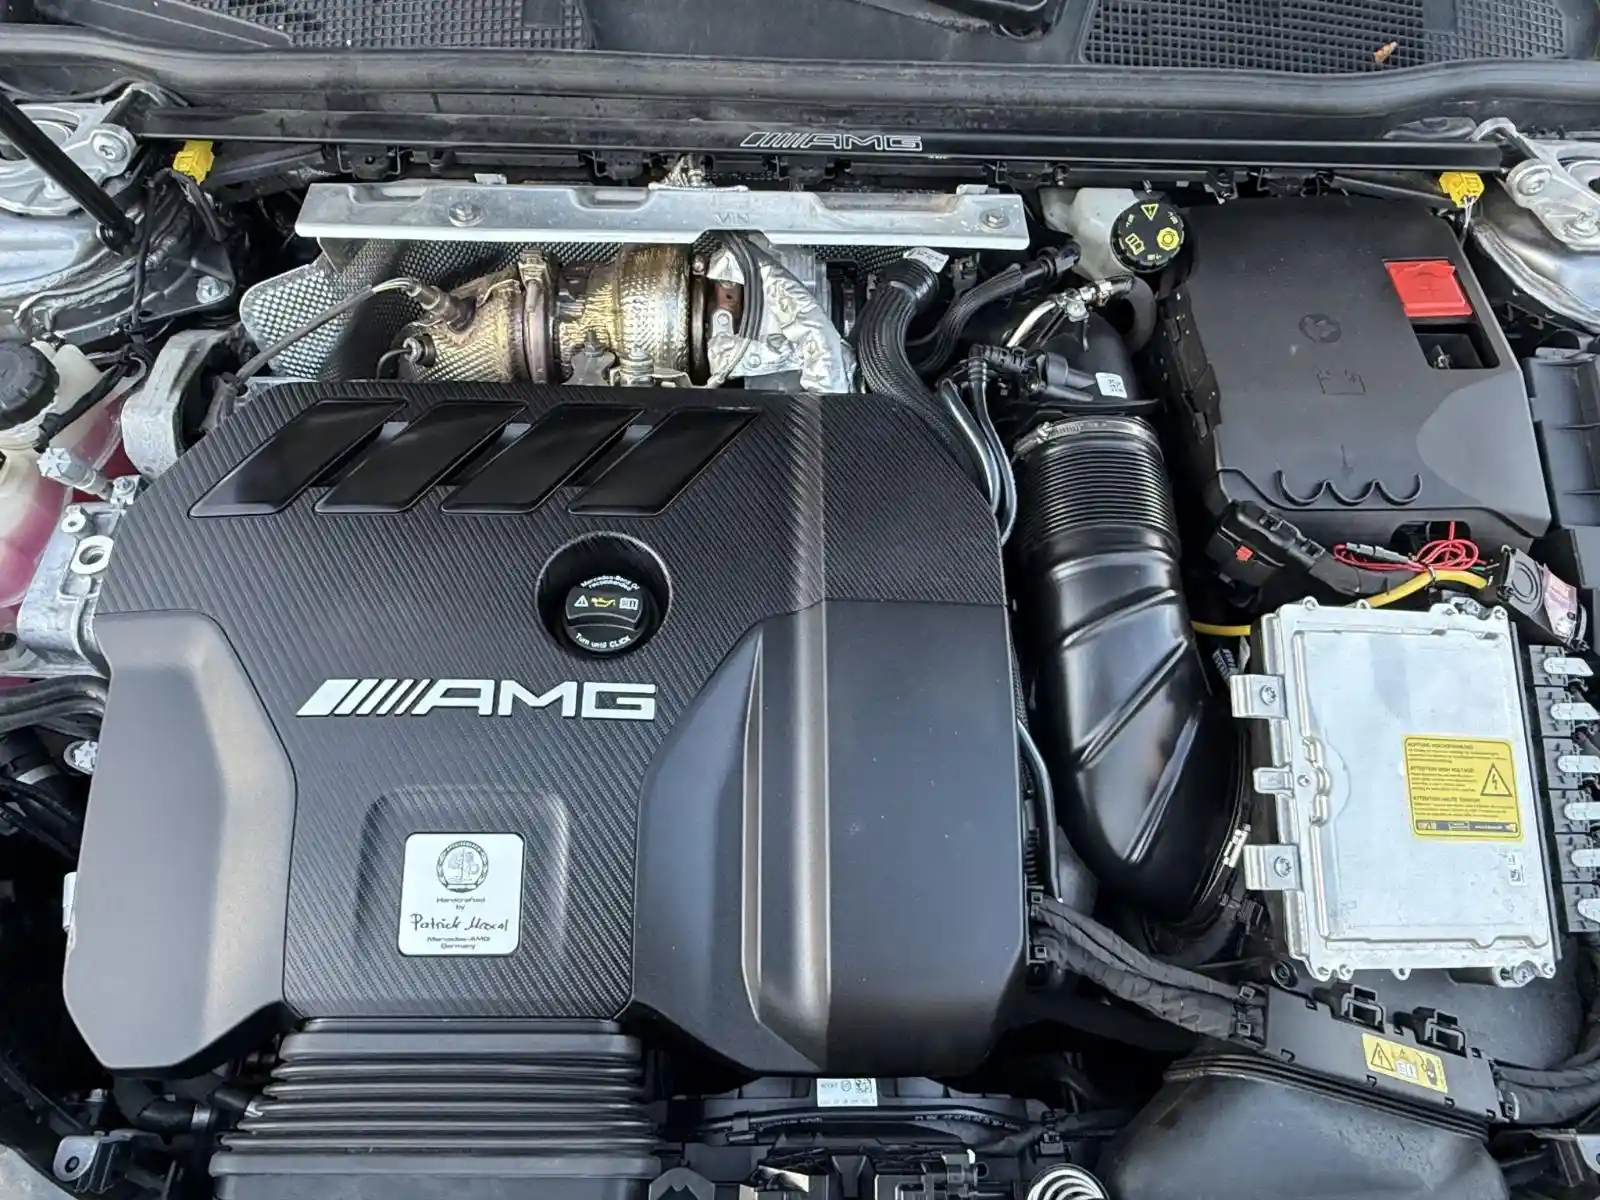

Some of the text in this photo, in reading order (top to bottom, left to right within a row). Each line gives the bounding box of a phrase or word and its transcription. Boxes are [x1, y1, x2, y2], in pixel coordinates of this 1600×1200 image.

[800, 133, 923, 151] AMG
[576, 632, 590, 645] Turn
[609, 635, 631, 648] CLICK
[411, 679, 656, 720] AMG
[410, 913, 461, 931] Patrick
